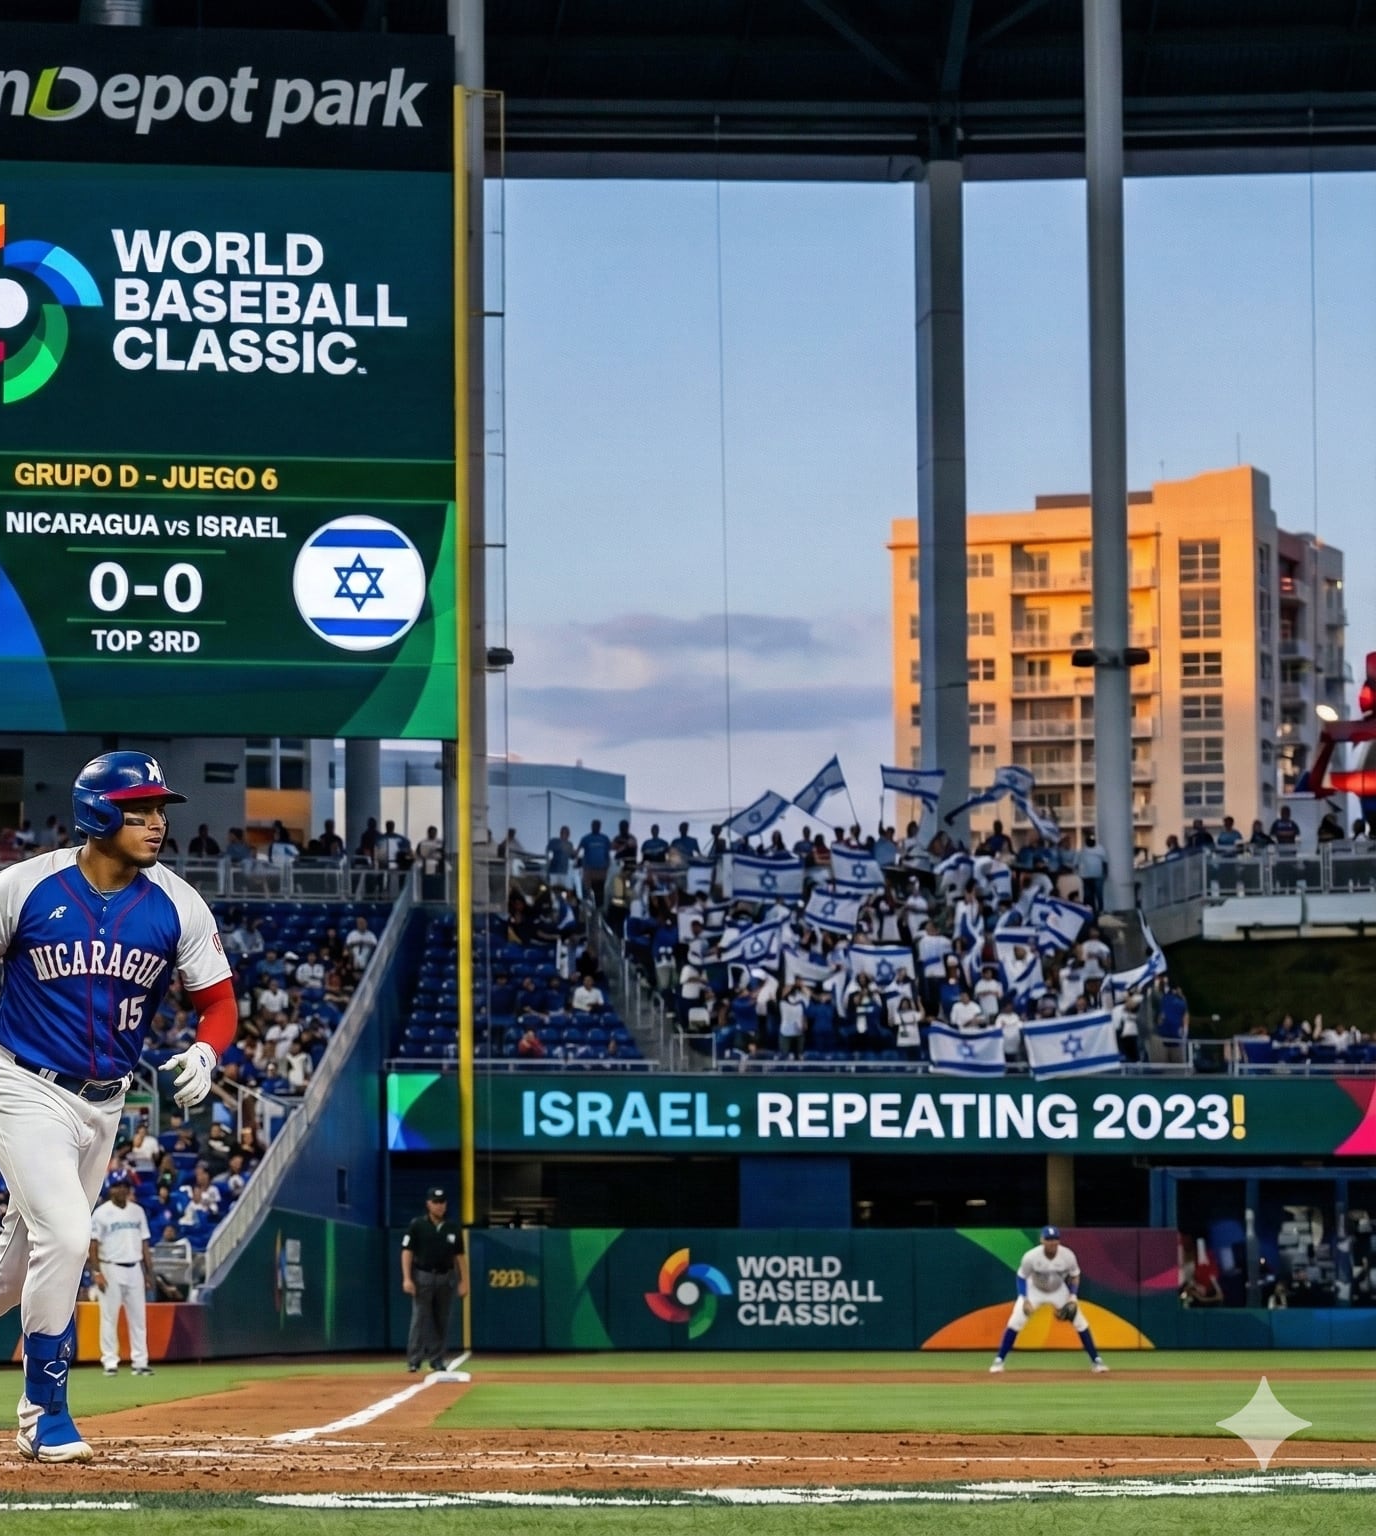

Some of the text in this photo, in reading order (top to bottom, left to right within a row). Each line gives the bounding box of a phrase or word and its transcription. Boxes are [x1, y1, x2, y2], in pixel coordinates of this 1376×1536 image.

[264, 67, 428, 138] park
[111, 229, 324, 276] WORLD
[114, 278, 408, 328] BASEBALL
[112, 327, 358, 375] CLASSIC
[14, 462, 112, 487] GRUPO
[119, 464, 139, 488] D
[162, 465, 256, 490] JUEGO
[261, 468, 278, 490] 6
[6, 511, 160, 536] NICARAGUA
[196, 515, 287, 539] ISRAEL
[91, 629, 201, 653] TOP 3RD
[29, 940, 167, 989] NICARAGUA
[118, 994, 147, 1032] 15
[523, 1091, 1246, 1140] ISRAEL: REPEATING 2023!
[737, 1256, 841, 1278] WORLD
[738, 1280, 883, 1302] BASEBALL
[738, 1303, 858, 1326] CLASSIC
